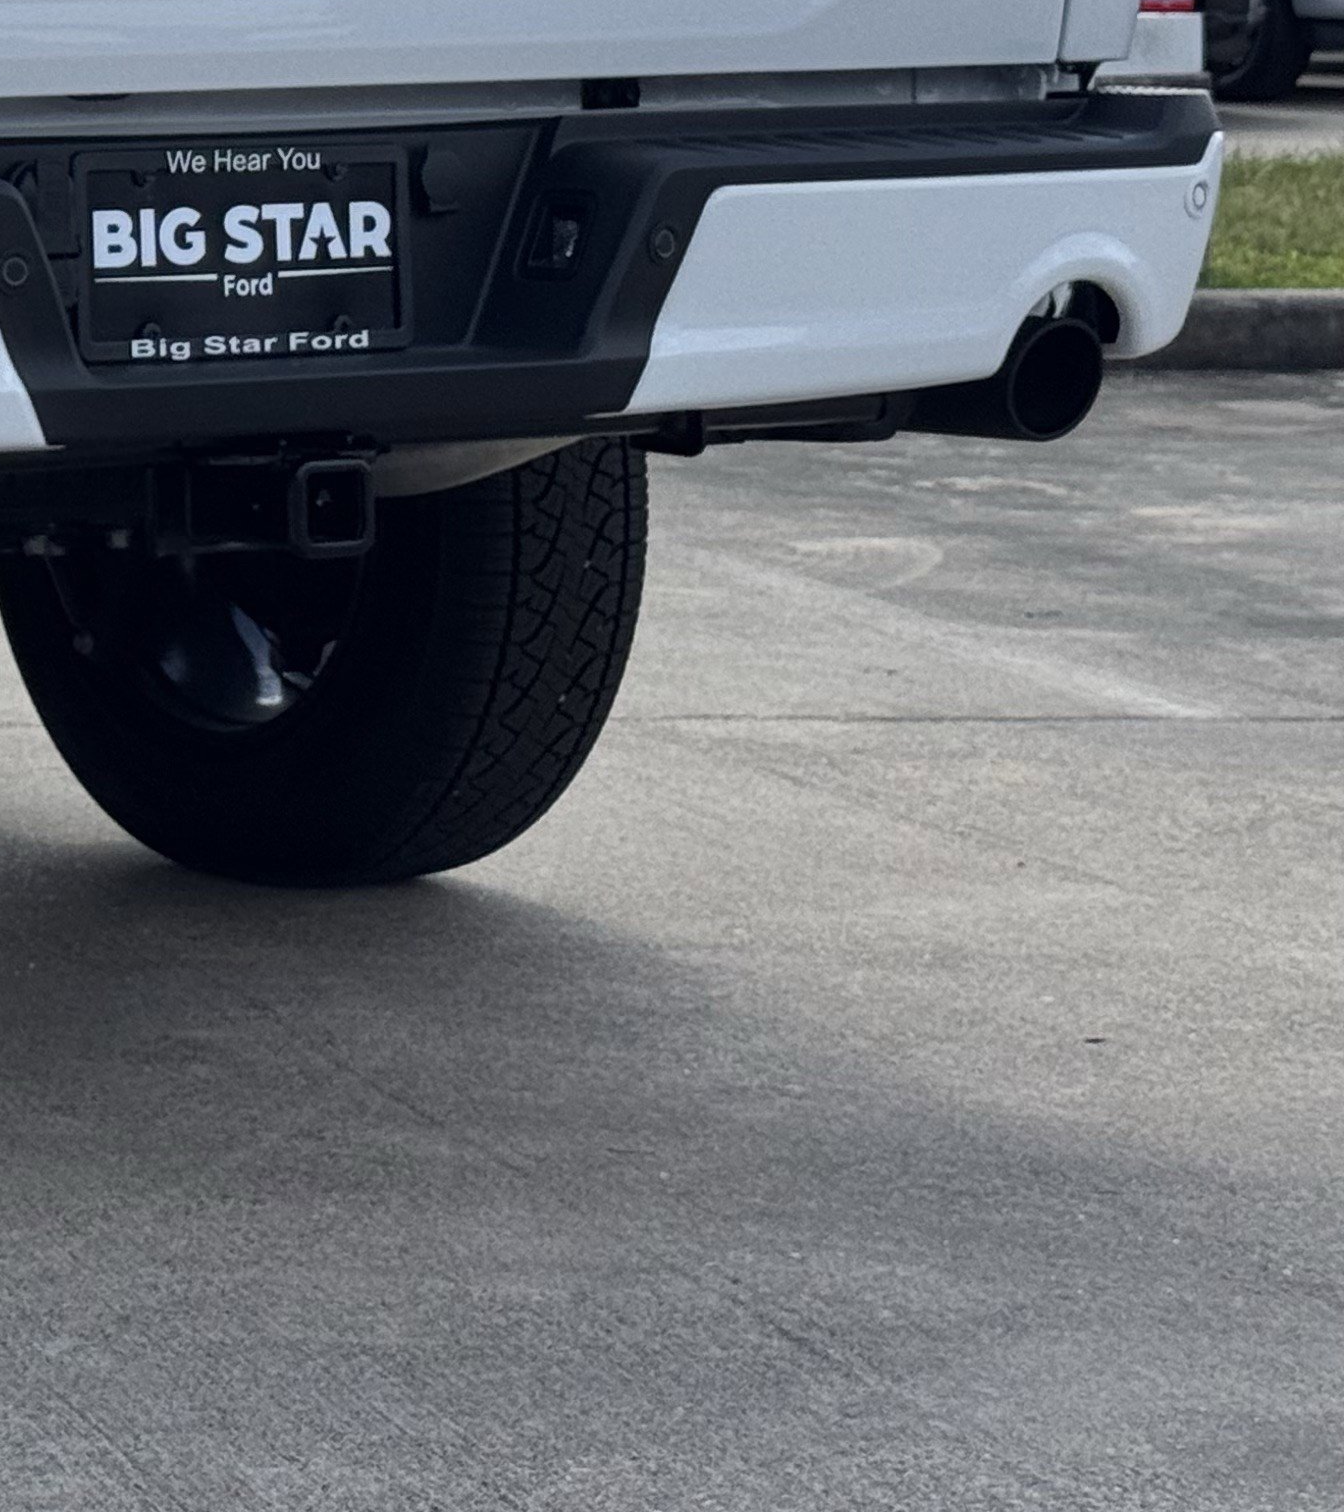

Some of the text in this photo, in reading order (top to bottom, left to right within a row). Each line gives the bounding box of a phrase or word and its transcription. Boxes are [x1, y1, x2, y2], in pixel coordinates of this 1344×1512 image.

[166, 147, 321, 174] We Hear You
[92, 200, 392, 269] BIG STAR
[223, 273, 273, 297] Ford
[131, 329, 369, 361] Big Star Ford
